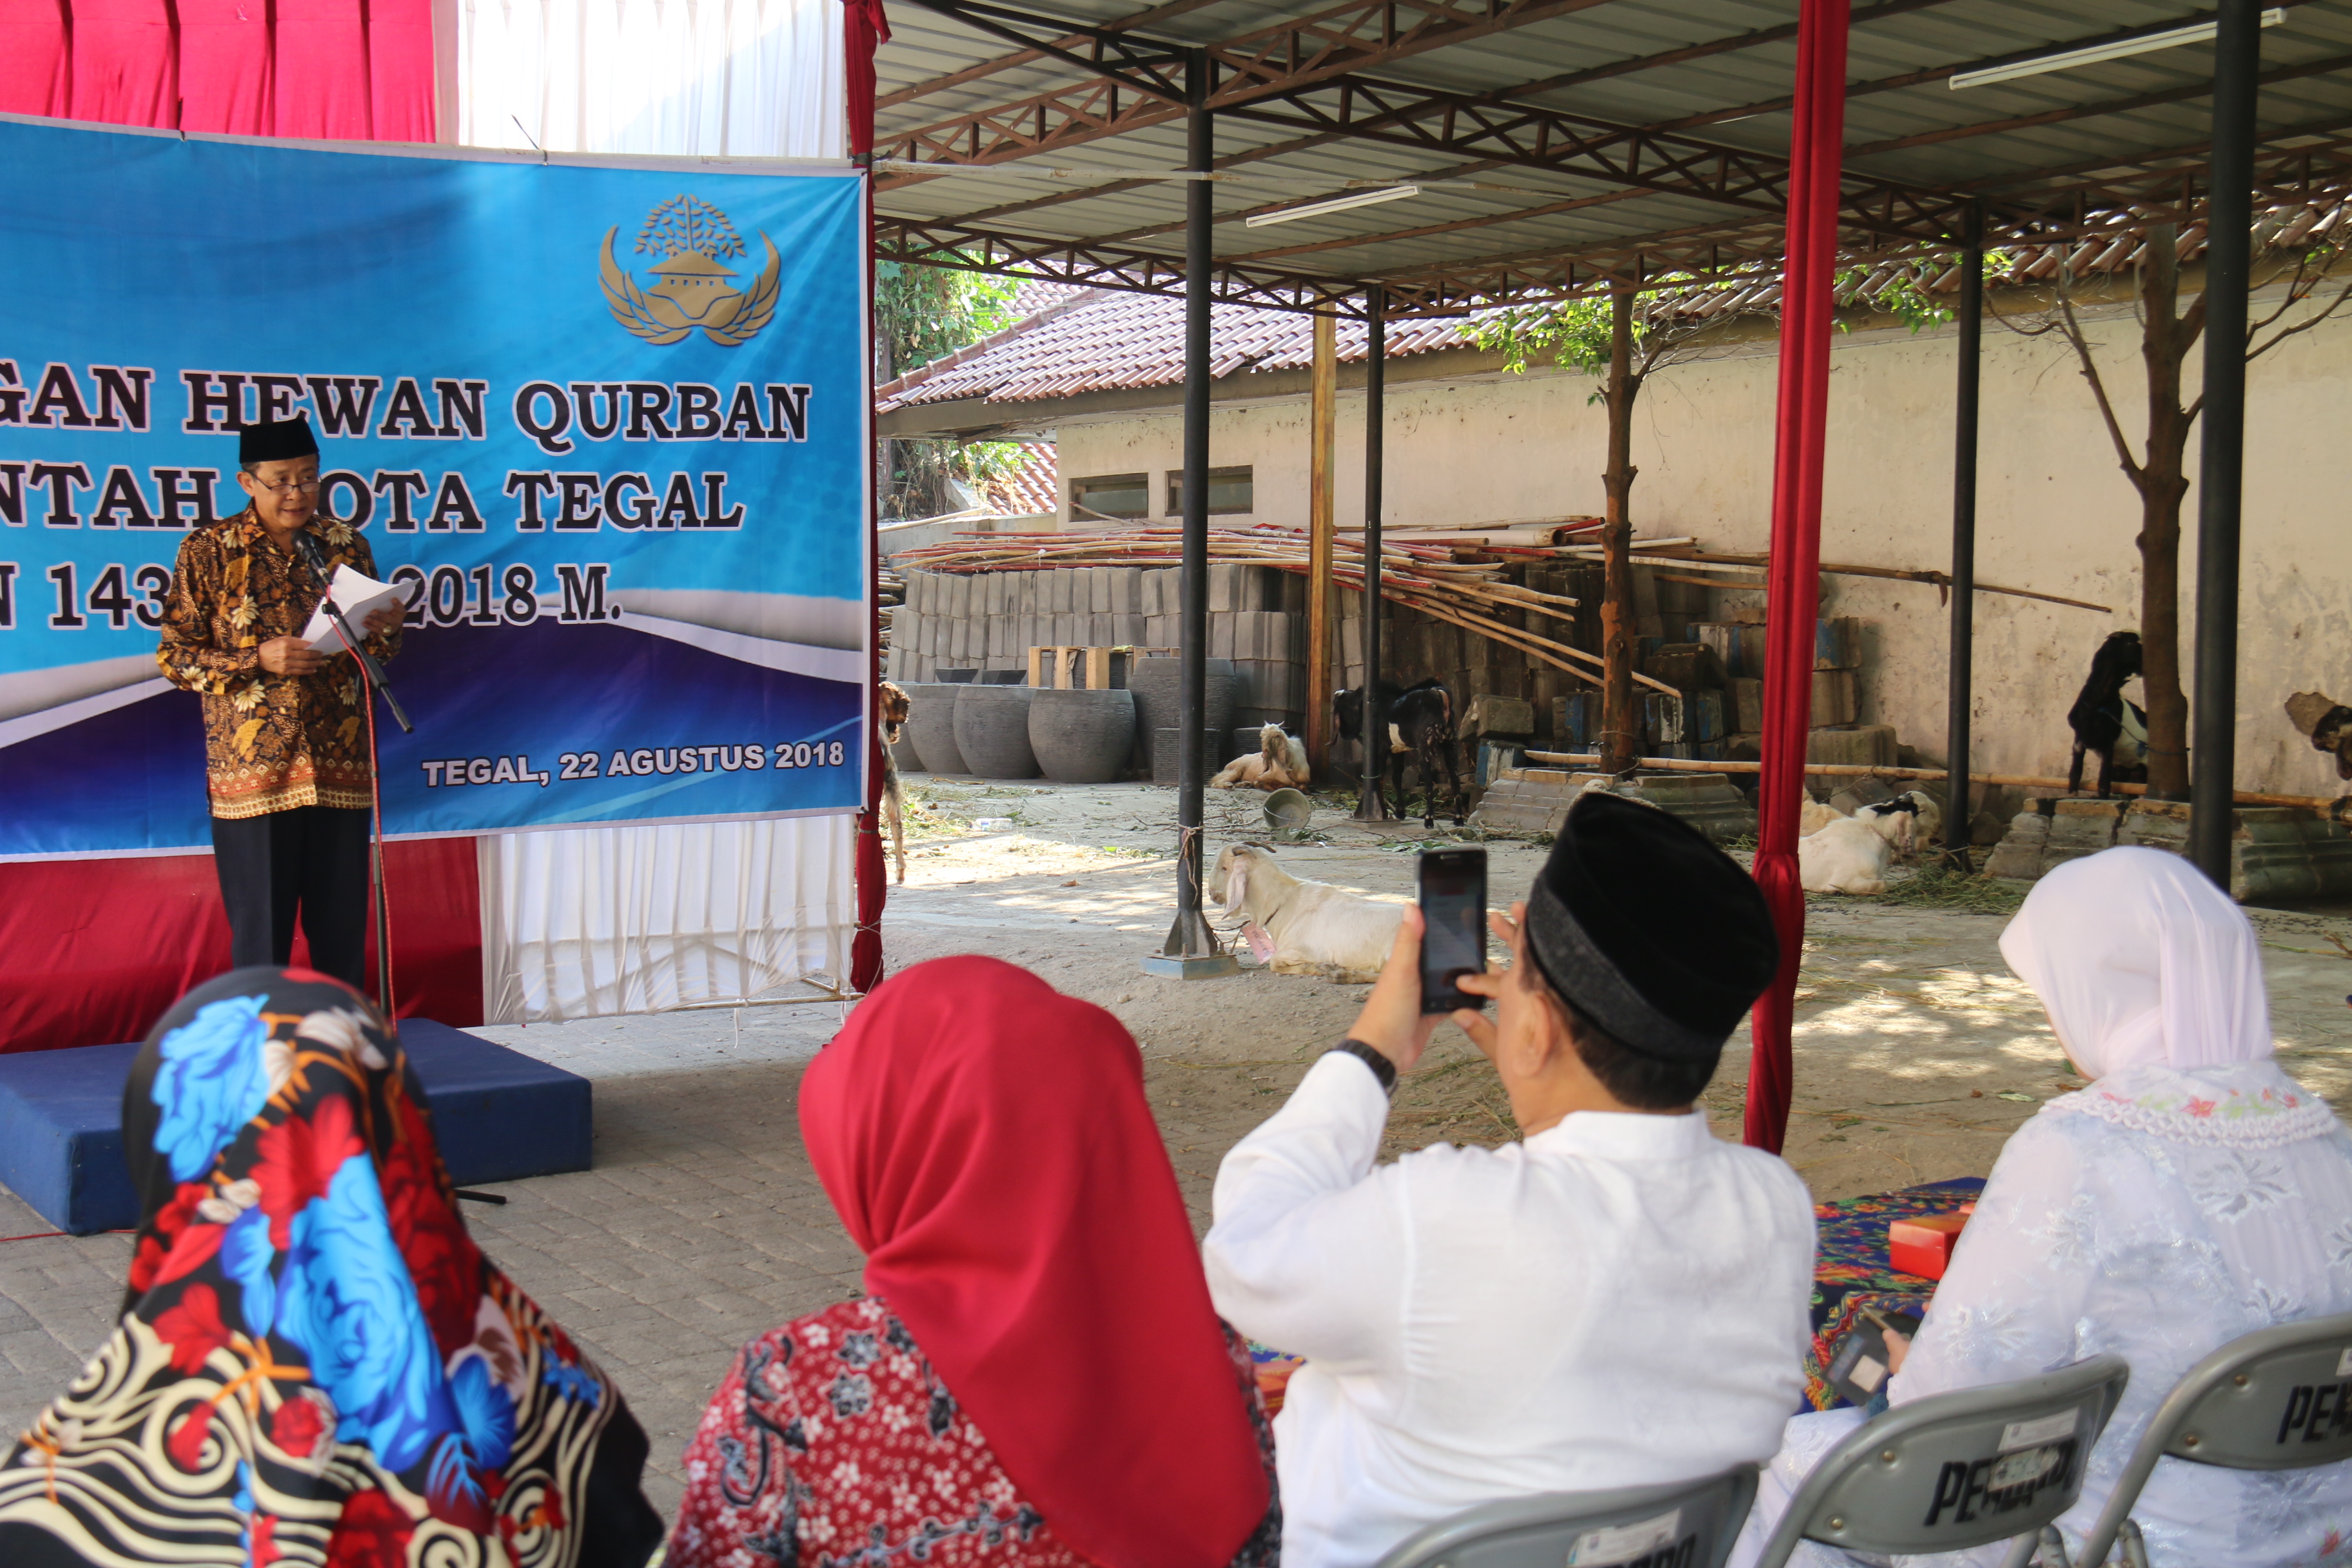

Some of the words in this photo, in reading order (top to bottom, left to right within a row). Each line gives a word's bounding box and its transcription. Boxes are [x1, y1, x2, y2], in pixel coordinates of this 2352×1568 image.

[181, 370, 489, 441] HEWAN
[513, 379, 813, 456] QURBAN
[316, 469, 487, 533] OTA
[503, 471, 747, 533] TEGAL
[46, 561, 174, 631] 143
[389, 564, 538, 629] 2018
[554, 564, 625, 625] M.
[422, 756, 550, 788] TEGAL,
[559, 753, 600, 780] 22
[606, 745, 766, 777] AGUSTUS
[774, 741, 845, 770] 2018
